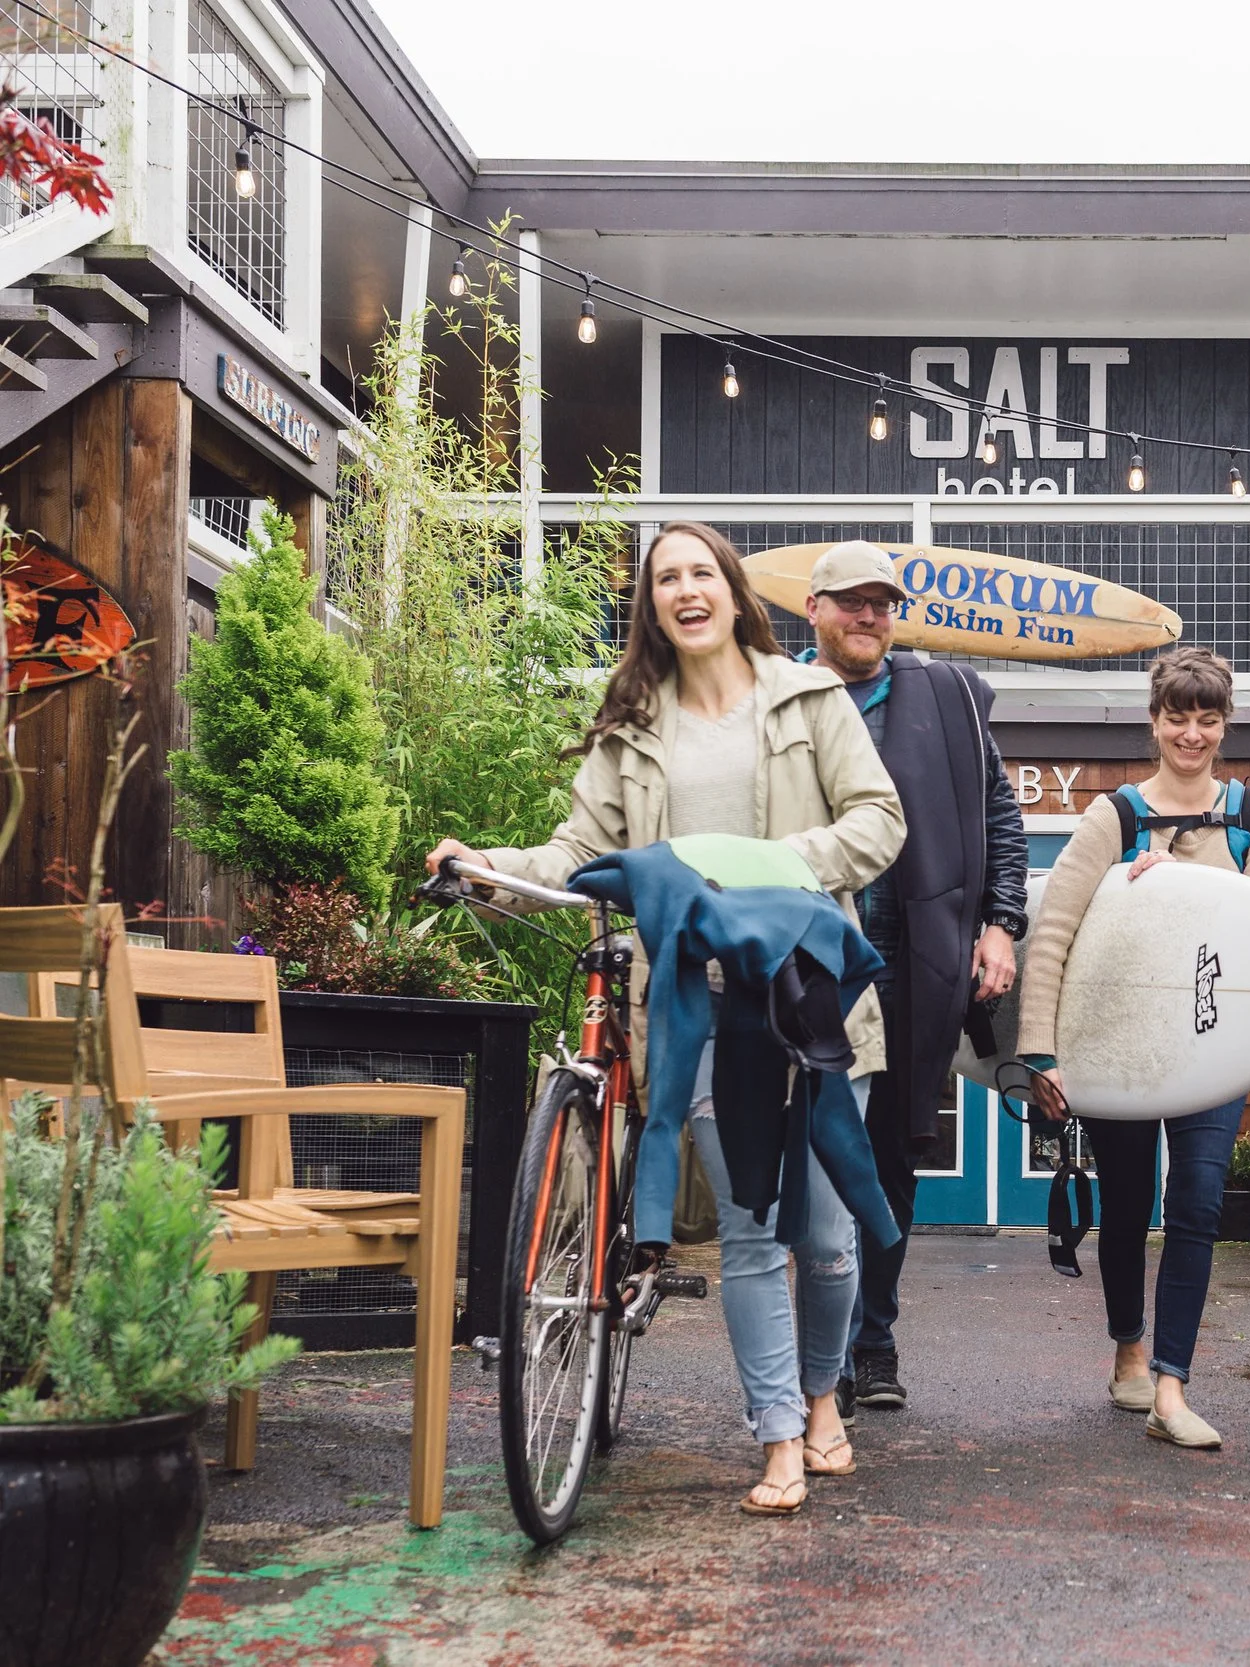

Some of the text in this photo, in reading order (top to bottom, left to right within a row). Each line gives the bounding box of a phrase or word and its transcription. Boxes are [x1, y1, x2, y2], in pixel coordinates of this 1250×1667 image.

[910, 346, 1130, 459] SALT
[888, 552, 1100, 618] OOKUM
[925, 602, 1004, 636] Skim
[1015, 615, 1075, 646] Fun
[1018, 765, 1081, 805] BY
